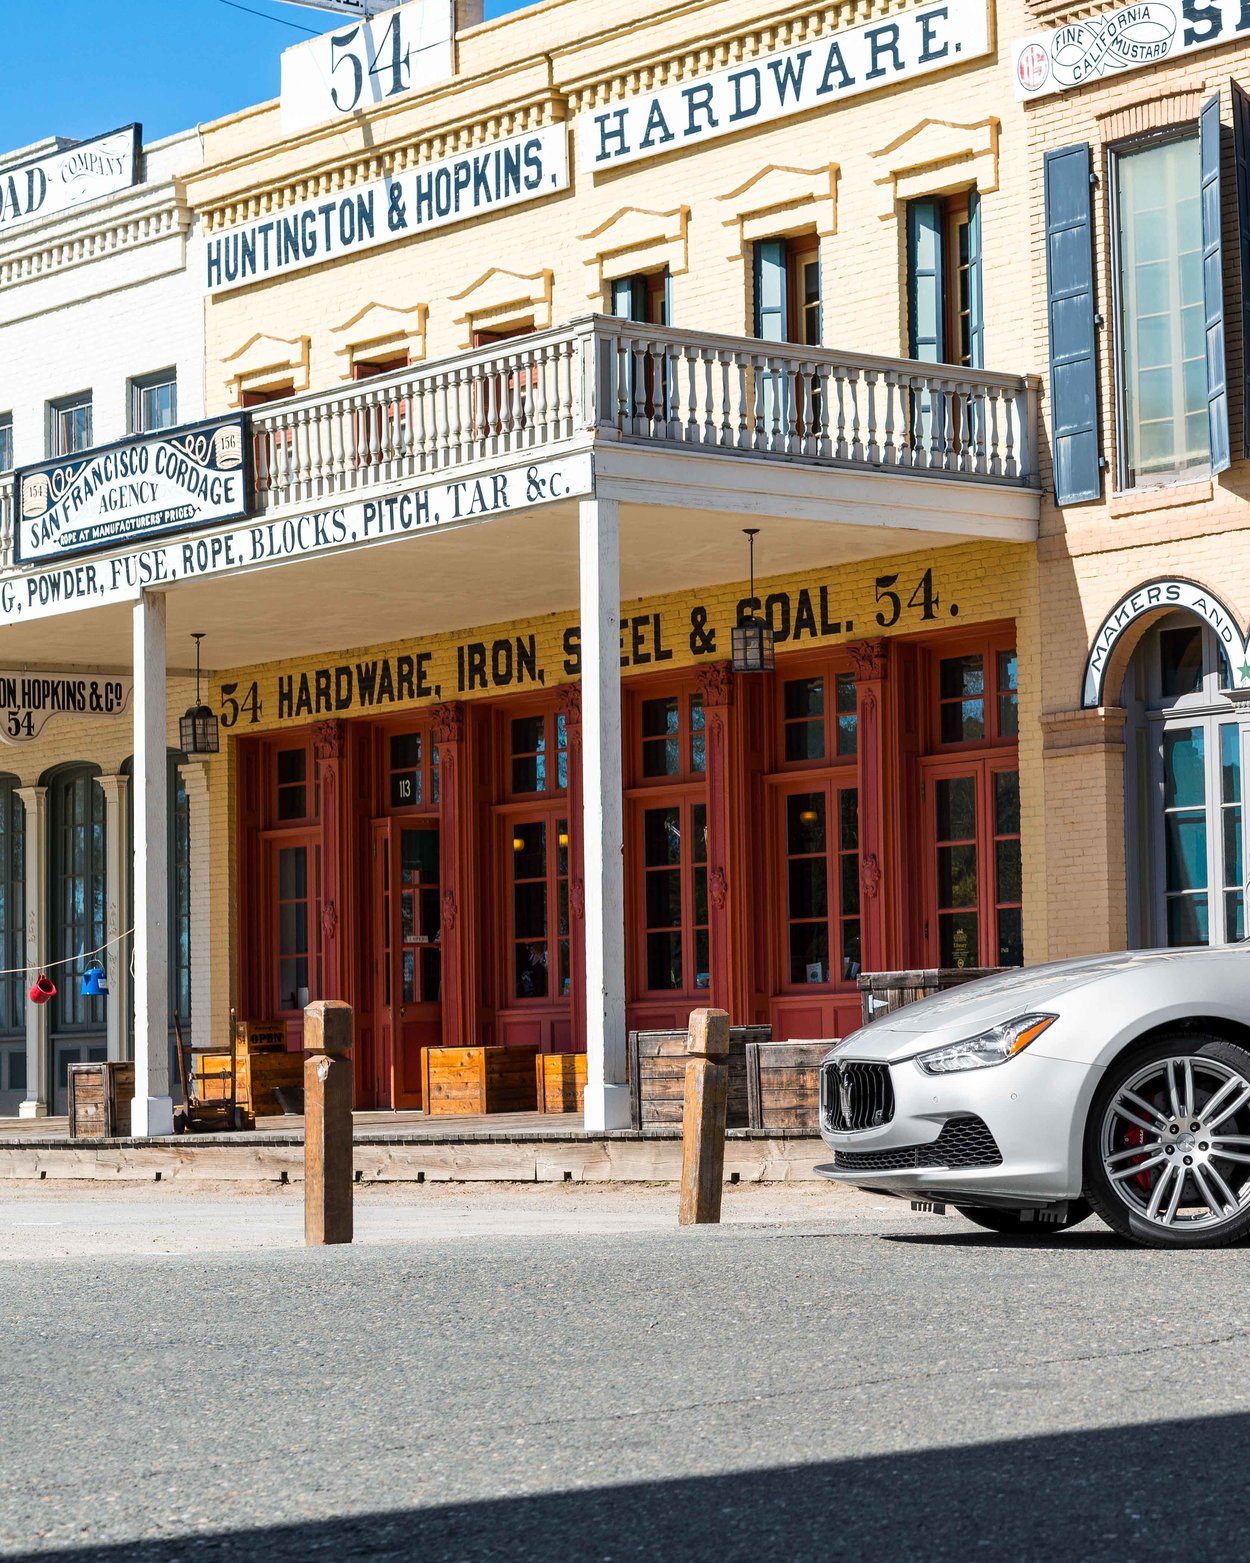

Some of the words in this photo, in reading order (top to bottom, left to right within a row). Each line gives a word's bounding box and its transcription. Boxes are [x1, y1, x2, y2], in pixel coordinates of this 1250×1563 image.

[1056, 28, 1085, 51] FINE
[1073, 6, 1151, 80] CALIFORNIA
[1112, 36, 1168, 60] MUSTARD
[331, 11, 411, 113] 54
[594, 7, 962, 162] HARDWARE.
[0, 167, 47, 221] AD
[61, 152, 127, 183] COMPANY
[207, 189, 375, 288] HUNTINGTON
[387, 182, 408, 231] &
[416, 138, 557, 224] HOPKINS,
[221, 435, 236, 450] 156
[29, 485, 43, 497] 154
[31, 511, 61, 548] SAN
[61, 446, 149, 523] FRANCISCO
[155, 445, 235, 505] CORDAGE
[99, 481, 159, 514] AGENCY
[27, 565, 105, 607] POWDER,
[109, 549, 177, 590] FUSE,
[182, 534, 244, 575] ROPE,
[249, 508, 357, 560] BLOCKS,
[363, 490, 440, 536] PITCH,
[447, 474, 511, 519] TAR
[60, 532, 77, 546] ROPE
[79, 530, 90, 542] AT
[164, 506, 195, 523] PRICES
[220, 681, 263, 727] 54
[278, 652, 441, 718] HARDWARE,
[457, 634, 545, 692] IRON,
[689, 605, 717, 656] &
[875, 567, 960, 628] 54.
[1091, 585, 1181, 673] MAKERS
[1192, 598, 1233, 643] AND
[21, 679, 86, 711] HOPKINS
[89, 681, 104, 712] &
[8, 711, 35, 736] 54
[399, 779, 411, 798] 113
[251, 1032, 283, 1044] OPEN
